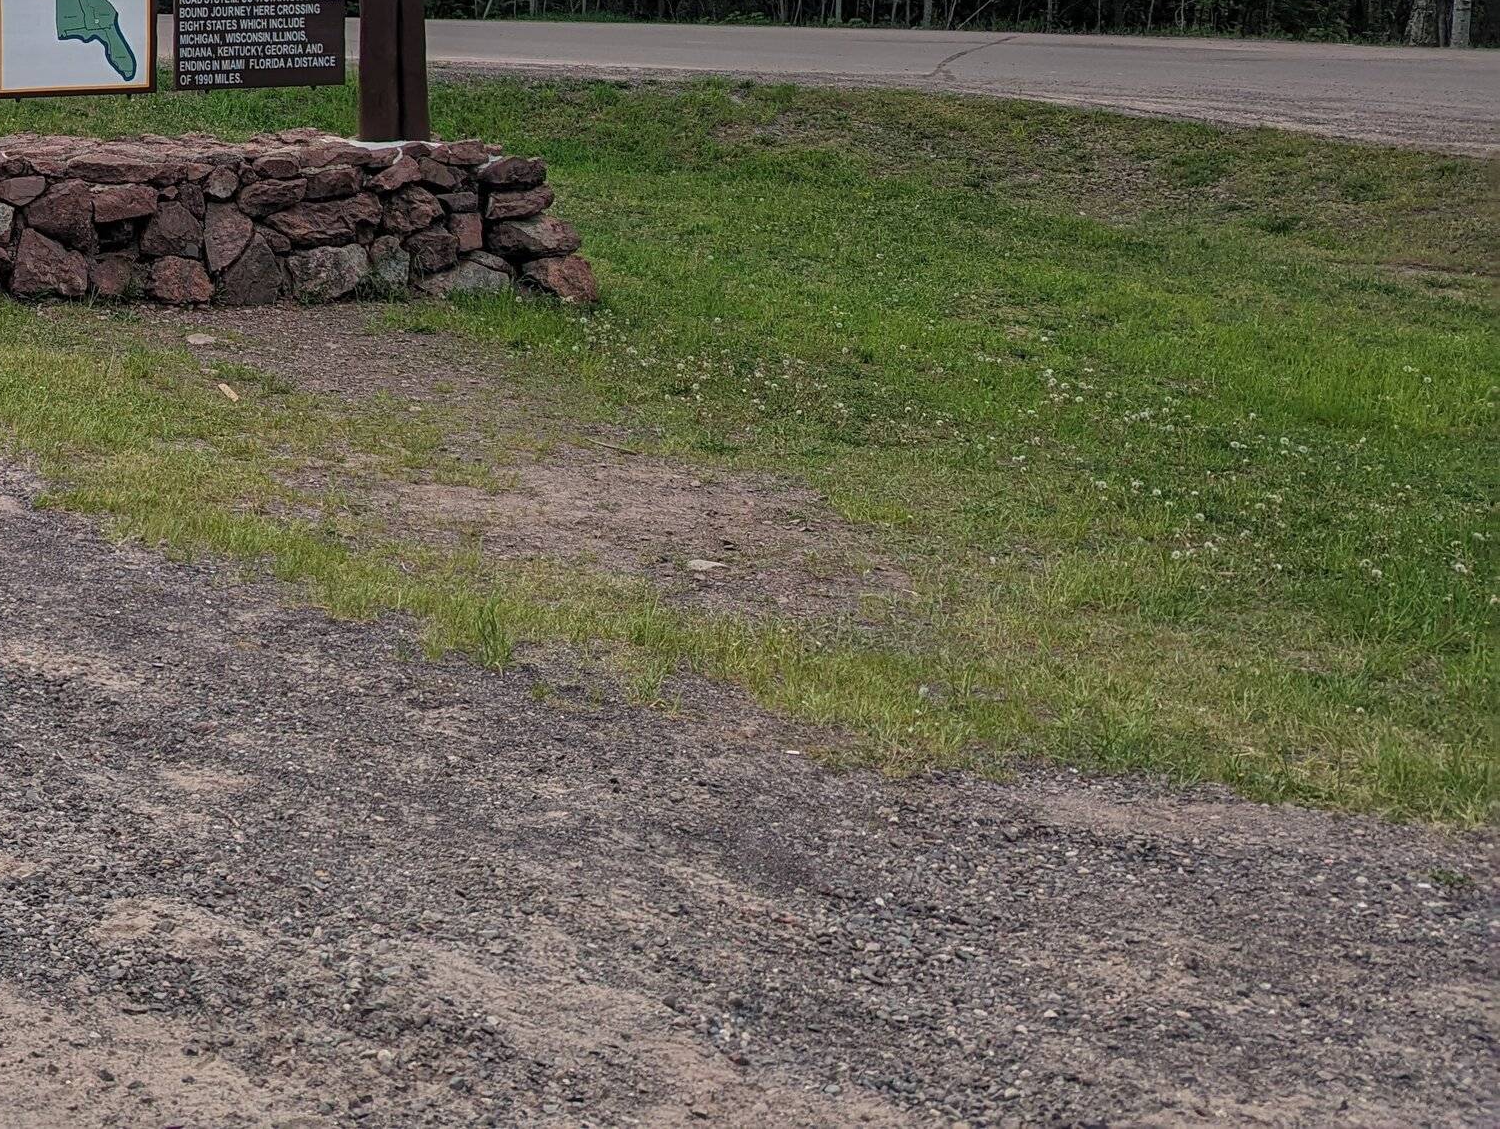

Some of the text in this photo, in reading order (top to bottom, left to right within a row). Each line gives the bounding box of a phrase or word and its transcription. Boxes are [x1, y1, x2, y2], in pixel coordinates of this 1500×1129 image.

[179, 4, 320, 18] BOUND JOURNEY HERE CROSSING
[179, 18, 305, 32] EIGHT STATES WHICH INCLUDE
[179, 34, 223, 45] MICHIGAN,
[265, 44, 303, 55] GEORGIA
[305, 43, 323, 54] AND
[179, 56, 336, 72] ENDING IN MIAMI FLORIDA A DISTANCE
[179, 73, 243, 85] OF 1990 MILES.
